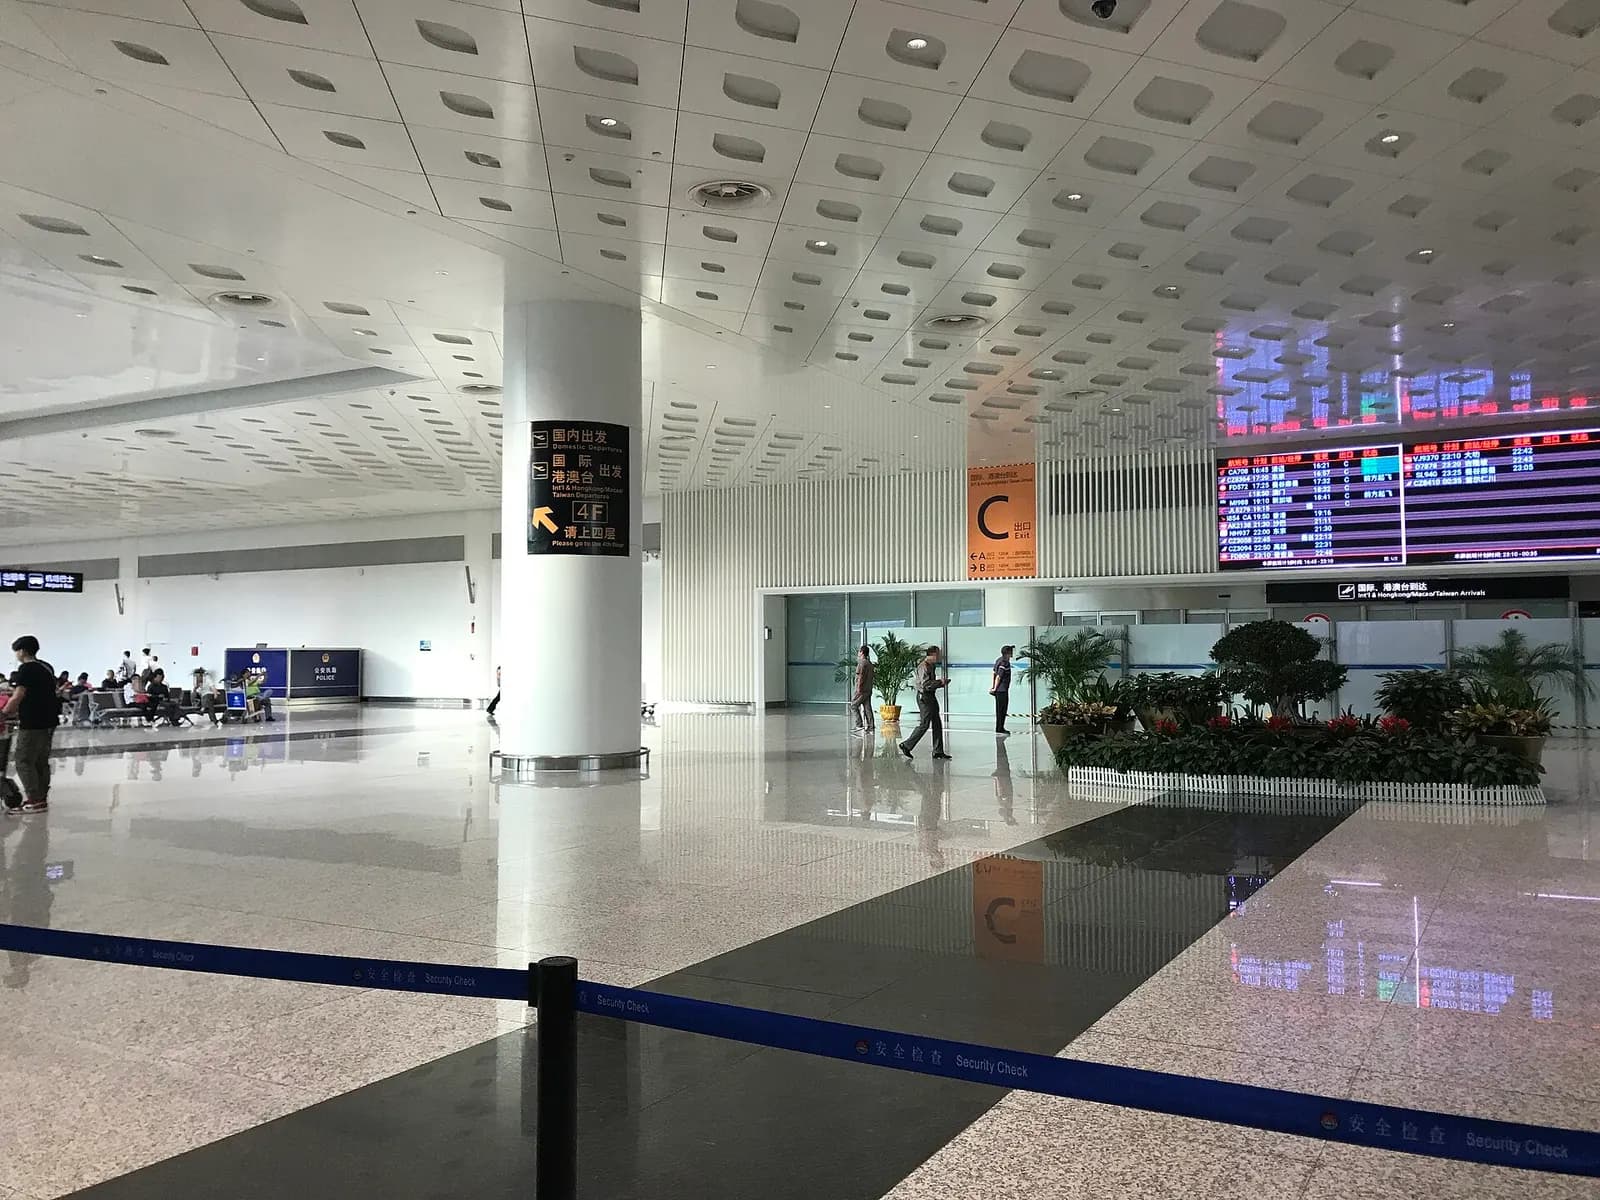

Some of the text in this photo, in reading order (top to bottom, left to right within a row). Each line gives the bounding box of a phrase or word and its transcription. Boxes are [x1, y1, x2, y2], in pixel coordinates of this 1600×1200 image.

[552, 428, 607, 444] 国内出发
[1543, 435, 1560, 443] 出口
[588, 444, 622, 453] Departures
[1339, 451, 1354, 459] 出口
[552, 470, 594, 484] 港澳台
[600, 463, 622, 478] 出发
[577, 503, 604, 521] 4F
[978, 495, 1009, 540] C
[563, 526, 616, 540] 请上四层
[1014, 521, 1031, 531] 出口
[978, 552, 986, 560] A
[980, 564, 986, 572] B
[1357, 582, 1428, 592] 国际、港澳台到达
[424, 972, 477, 987] Security Check
[597, 993, 650, 1014] Security Check
[875, 1040, 942, 1066] 安全检查
[956, 1054, 1028, 1078] Security Check
[1350, 1113, 1446, 1145] 安全检查
[1466, 1131, 1569, 1159] Security Check
